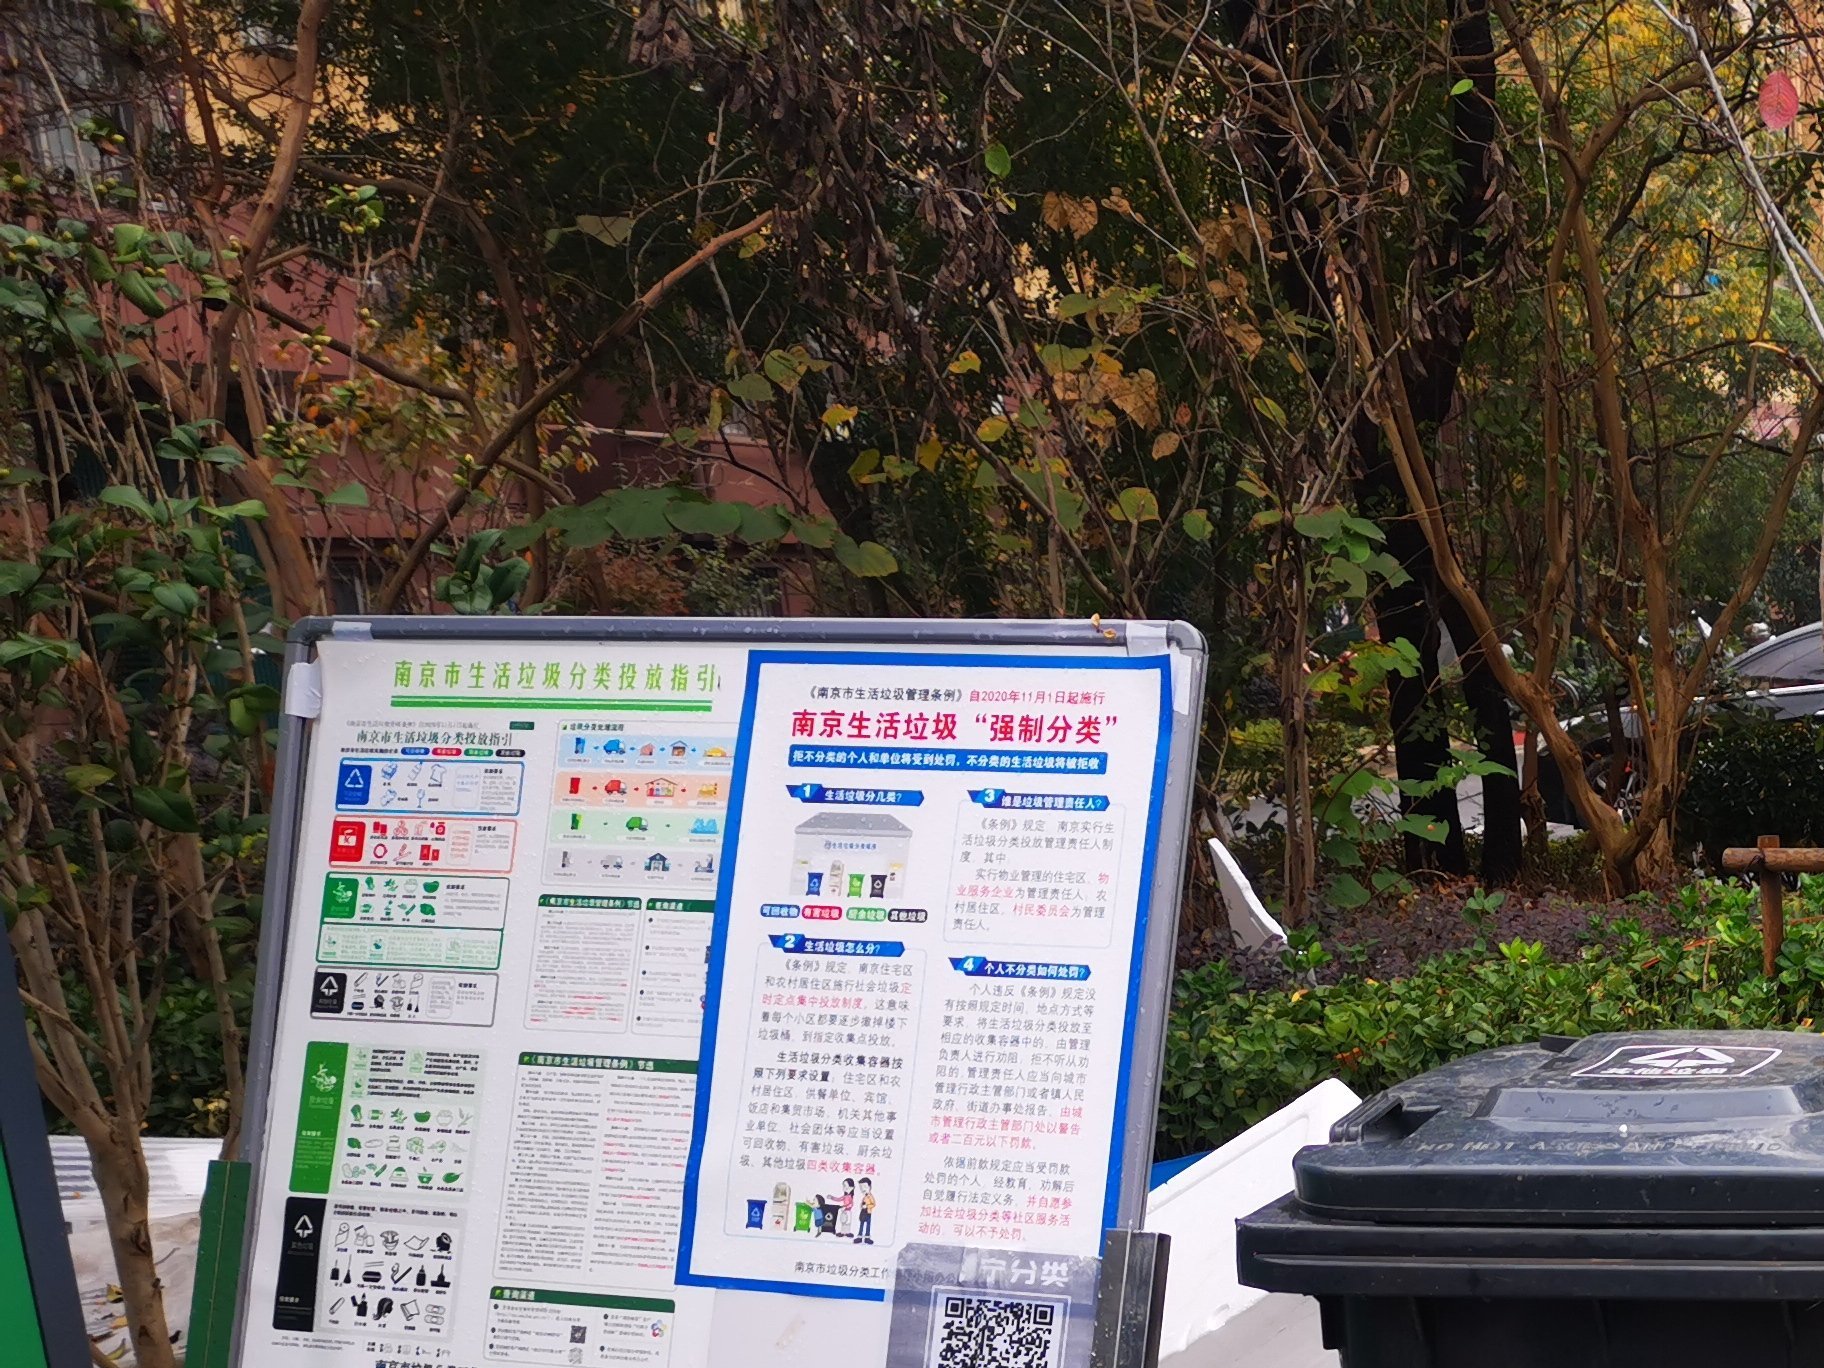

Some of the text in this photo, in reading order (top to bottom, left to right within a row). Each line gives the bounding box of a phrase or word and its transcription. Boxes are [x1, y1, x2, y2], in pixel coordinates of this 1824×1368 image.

[393, 660, 716, 692] 南京市生活垃圾分类投放指引
[809, 685, 1105, 706] 《南京市生活垃圾管理条例》 自2020年11月1日起施行
[791, 709, 1118, 745] 南京生活垃圾“强制分类”
[356, 730, 513, 747] 南京市生活垃圾分类投放指引
[803, 785, 811, 798] 1
[984, 789, 995, 803] 3
[784, 935, 796, 948] 2
[964, 958, 974, 971] 4
